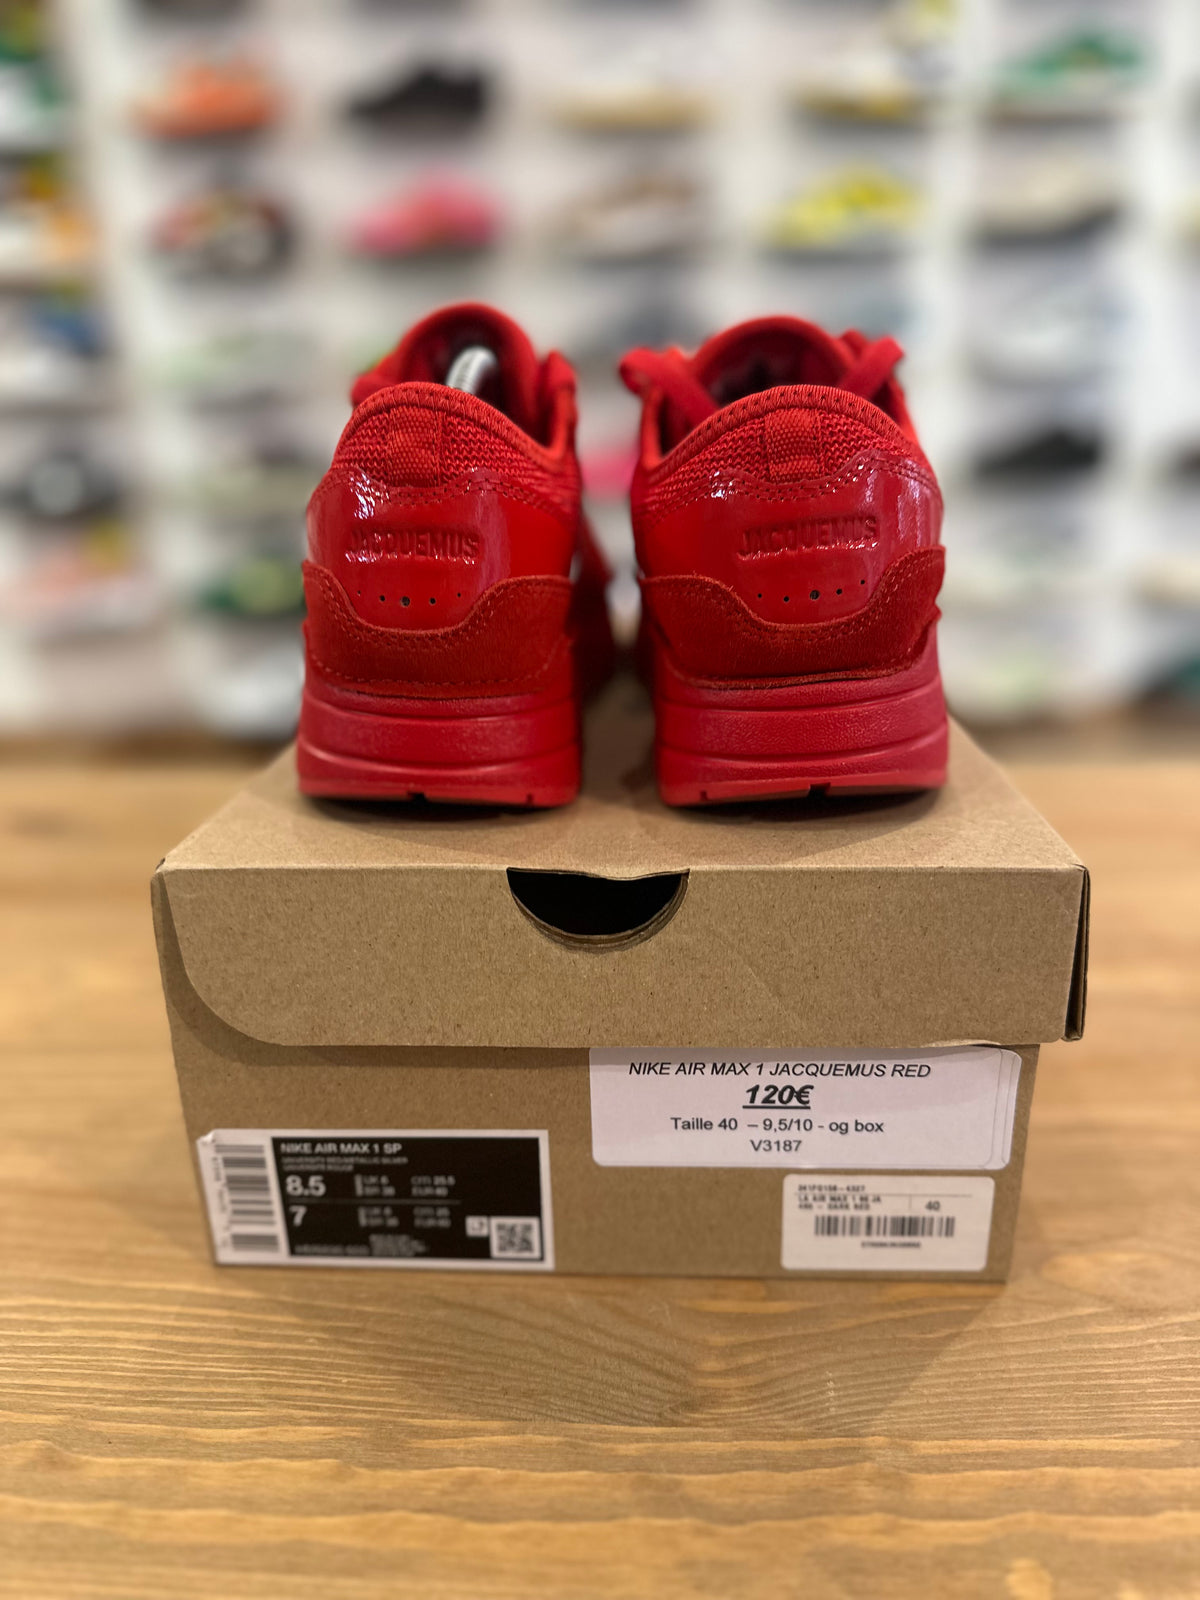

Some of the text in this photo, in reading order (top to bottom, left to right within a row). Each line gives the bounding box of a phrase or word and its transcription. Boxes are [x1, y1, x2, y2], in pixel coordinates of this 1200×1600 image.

[345, 529, 481, 565] JACQUEMUS
[736, 515, 879, 561] JACQUEMUS
[629, 1062, 931, 1078] NIKE AIR MAX 1 JACQUEMUS RED
[743, 1084, 815, 1109] 120€
[670, 1117, 713, 1130] Taille
[718, 1118, 738, 1130] 40
[763, 1118, 813, 1133] 9,5/10
[829, 1120, 849, 1135] og
[854, 1119, 884, 1132] box
[281, 1143, 402, 1154] NIKE AIR MAX 1 SP
[750, 1139, 802, 1152] V3187
[286, 1175, 326, 1196] 8.5
[290, 1205, 307, 1226] 7
[925, 1201, 941, 1211] 40
